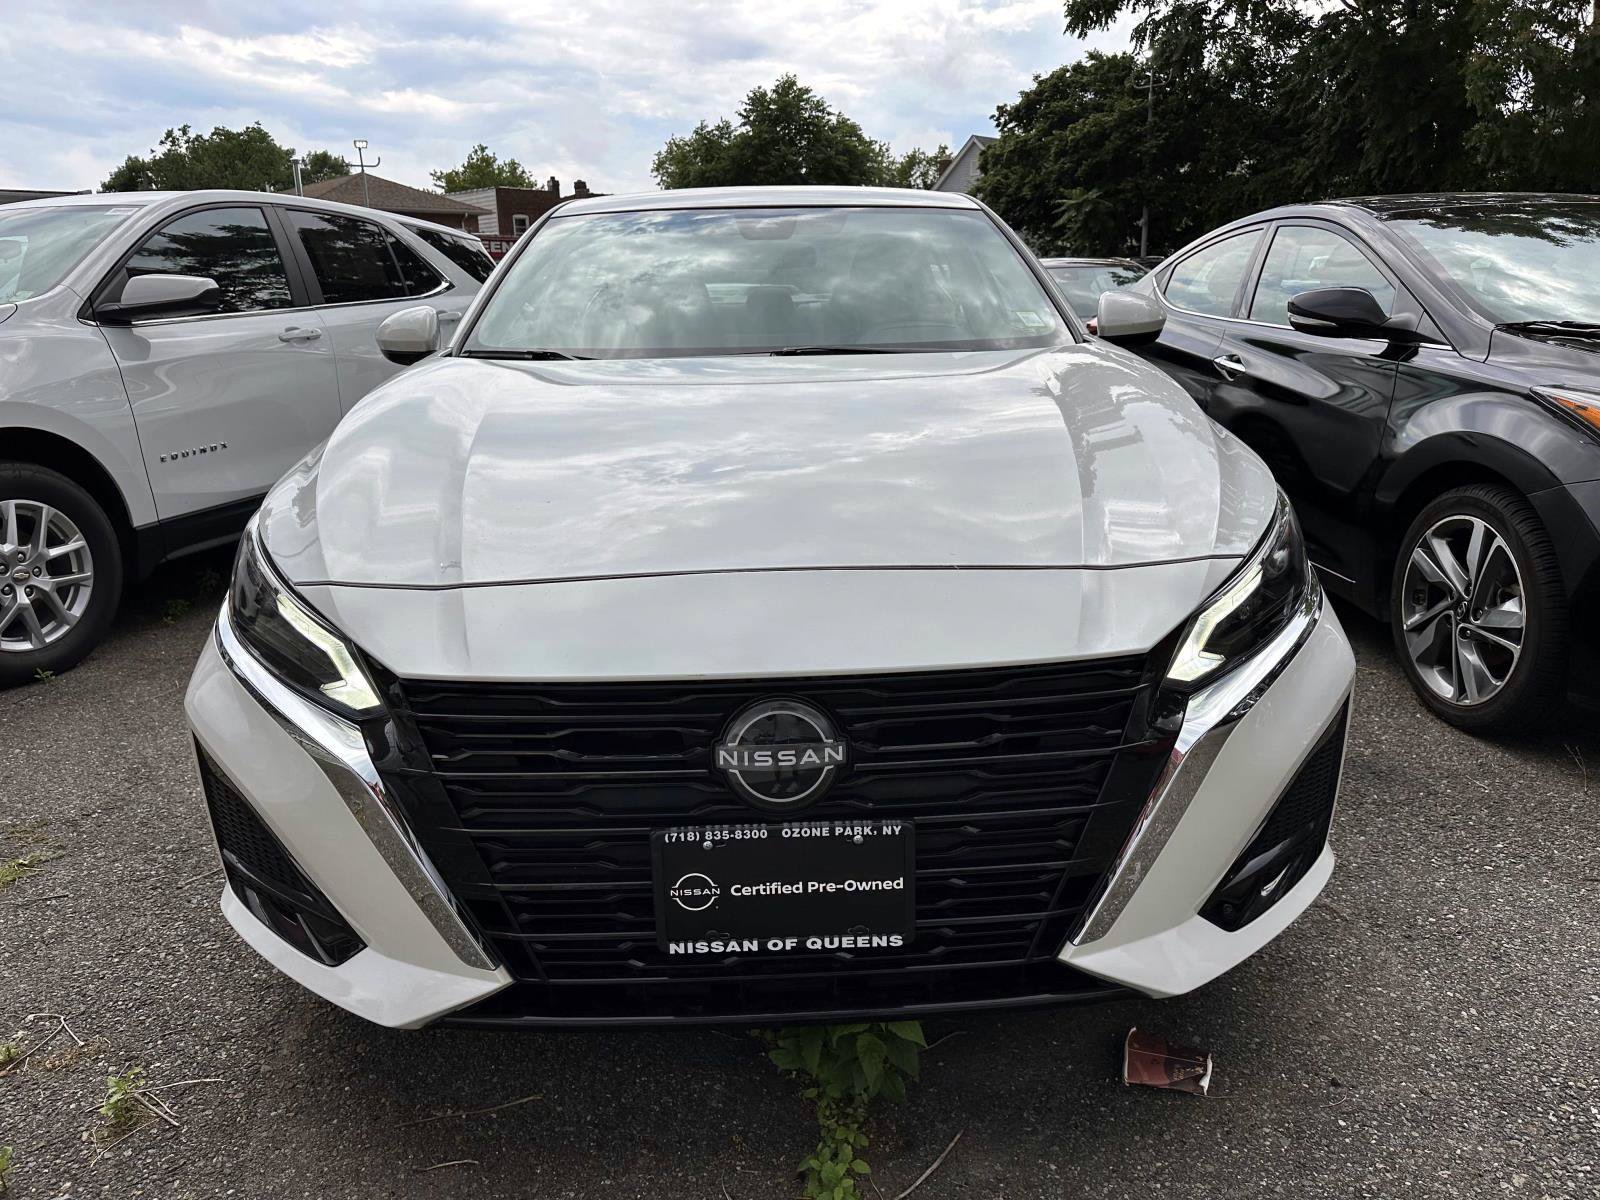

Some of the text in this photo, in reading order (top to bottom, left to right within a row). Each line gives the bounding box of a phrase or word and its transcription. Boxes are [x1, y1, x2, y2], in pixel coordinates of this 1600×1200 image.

[160, 441, 228, 463] EQUINOX
[719, 745, 843, 767] NISSAN
[664, 825, 902, 843] (718) 835-8300 OZONE PARK, NY
[670, 887, 720, 897] NISSAN
[730, 877, 904, 896] Certified Pre-Owned
[669, 935, 904, 954] NISSAN OF QUEENS
